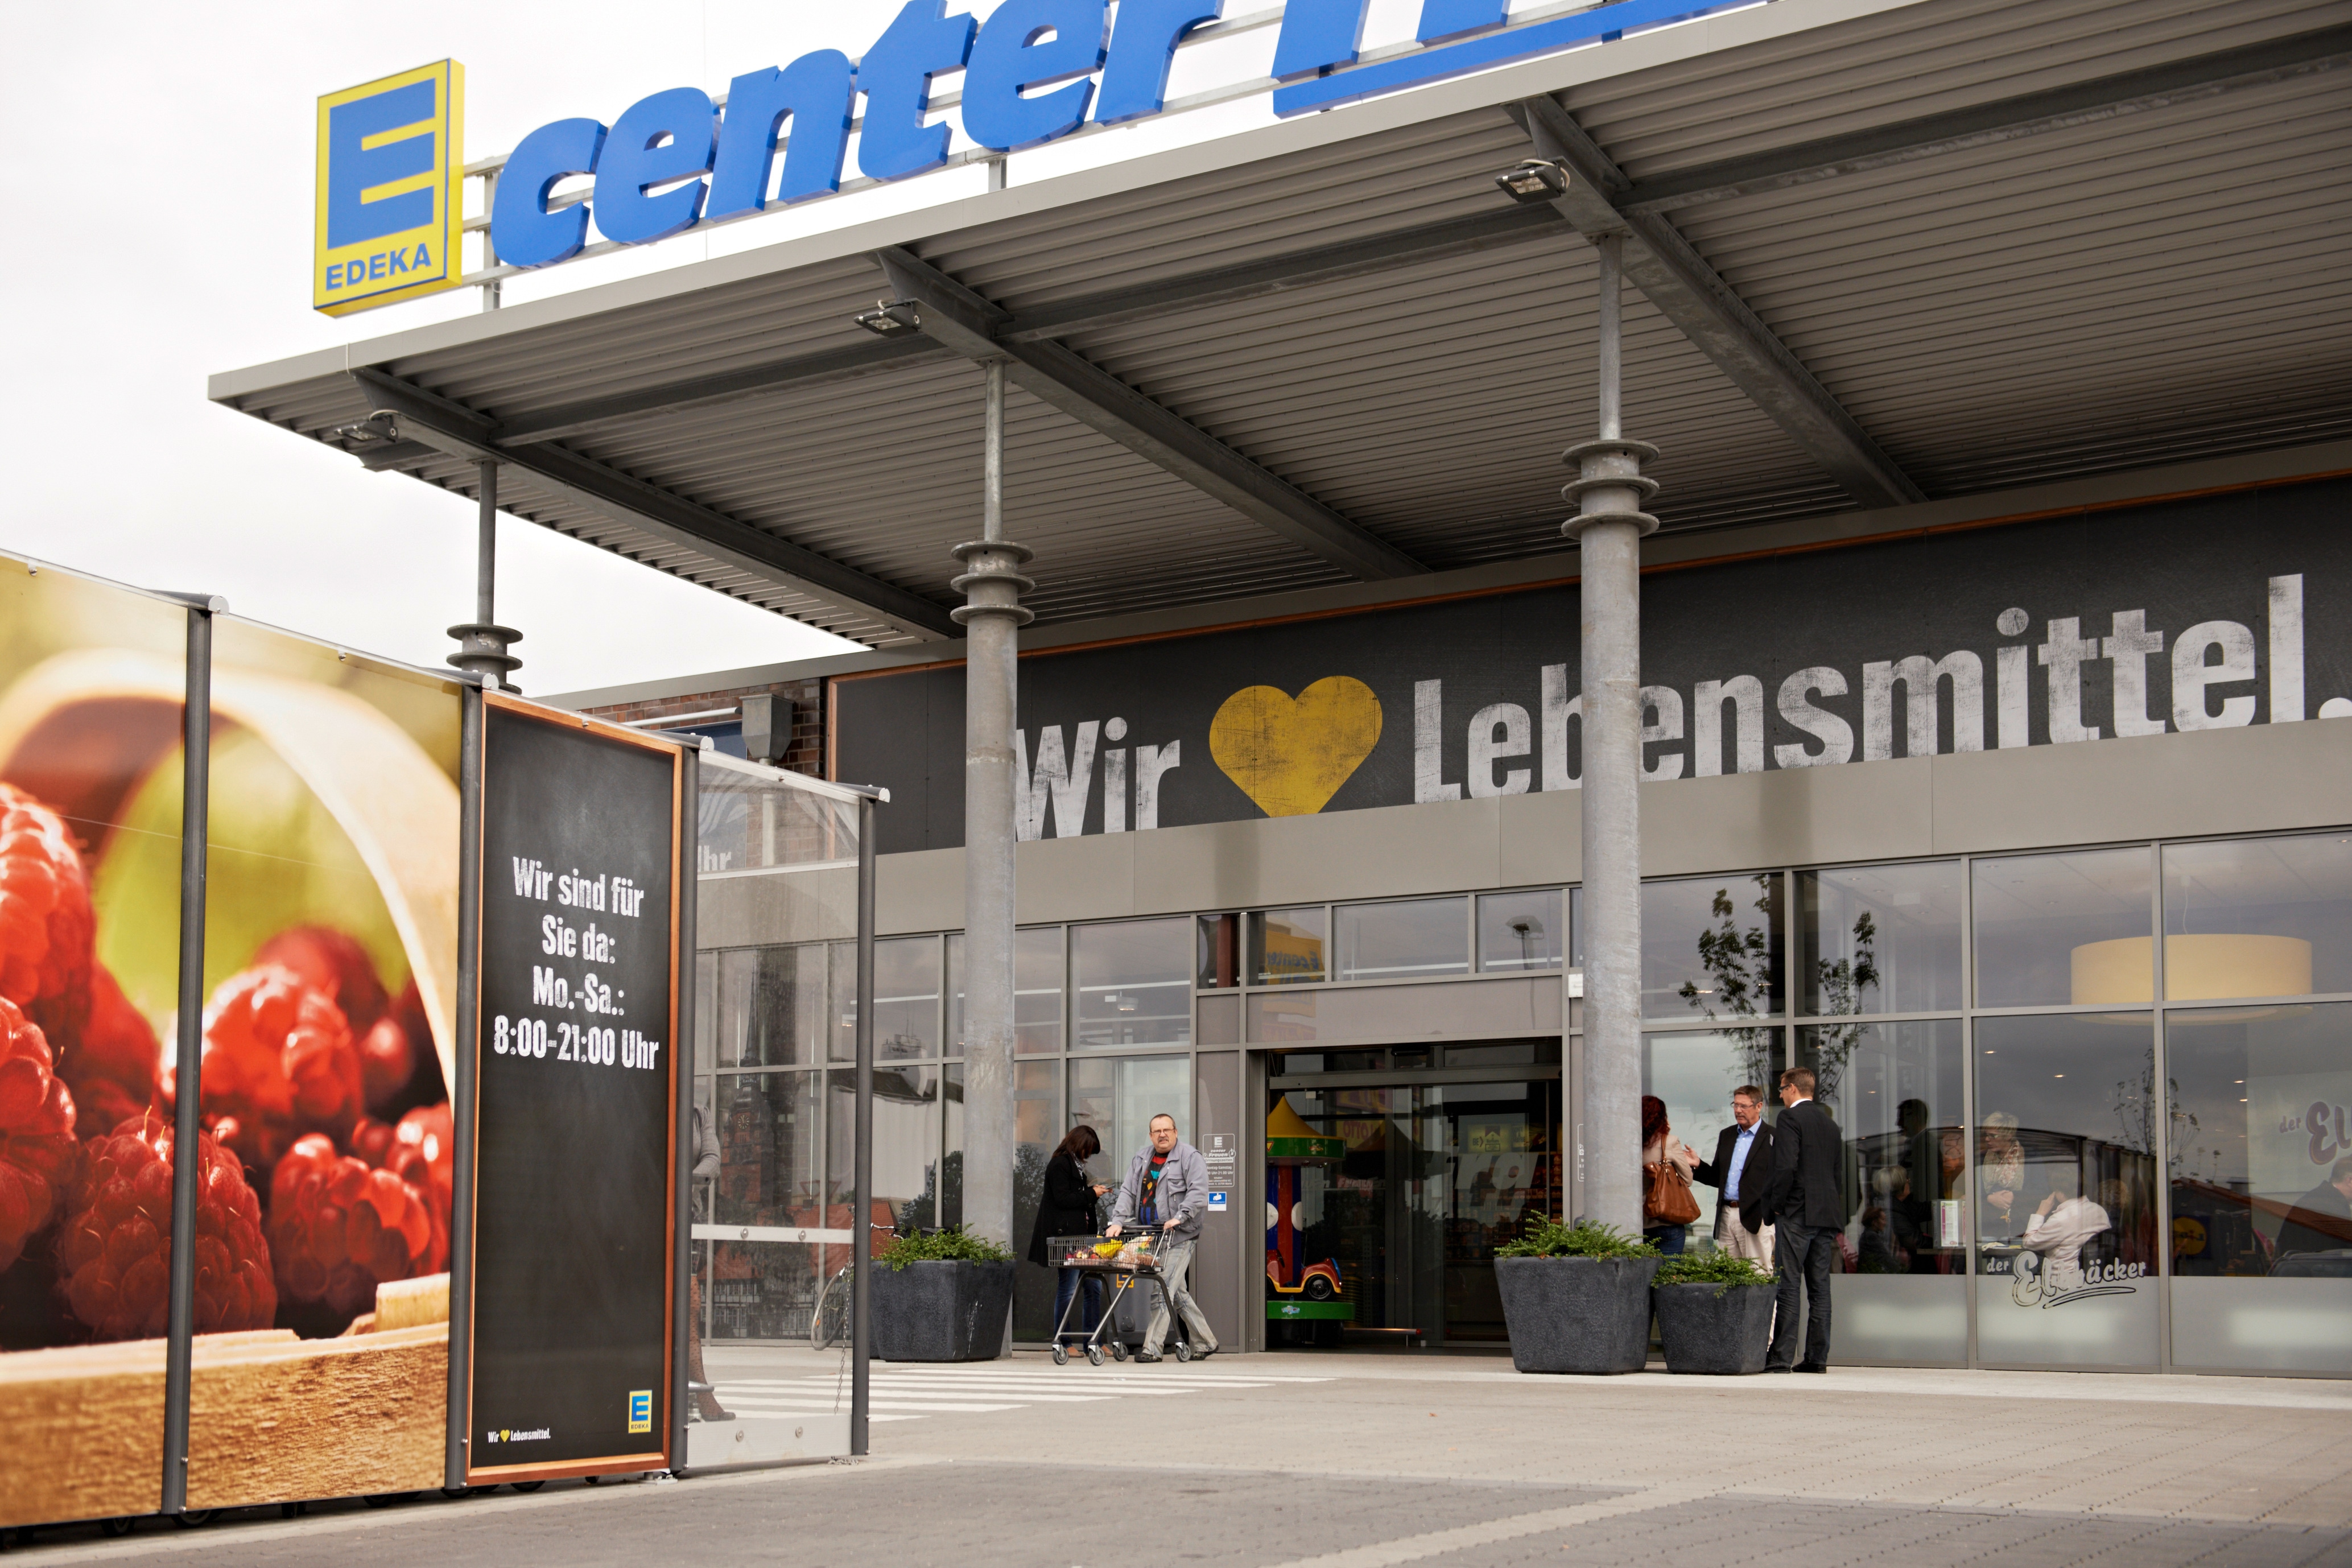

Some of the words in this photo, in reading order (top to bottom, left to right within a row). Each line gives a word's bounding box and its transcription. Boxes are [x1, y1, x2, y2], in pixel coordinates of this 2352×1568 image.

[490, 0, 1222, 269] center
[327, 77, 436, 249] E
[325, 243, 431, 291] EDEKA
[1016, 717, 1180, 841] Wir
[513, 857, 553, 902] Wir
[558, 868, 605, 911] sind
[612, 876, 644, 918] für
[542, 914, 576, 958] Sie
[583, 923, 616, 964] da:
[533, 965, 625, 1016] Mo.-Sa.:
[493, 1015, 616, 1067] 8:00-21:00
[621, 1029, 659, 1070] Uhr
[2279, 1115, 2301, 1133] der
[1986, 1257, 2009, 1273] der
[632, 1395, 649, 1421] E
[488, 1431, 500, 1443] Wir
[510, 1427, 551, 1441] Lebensmittel.
